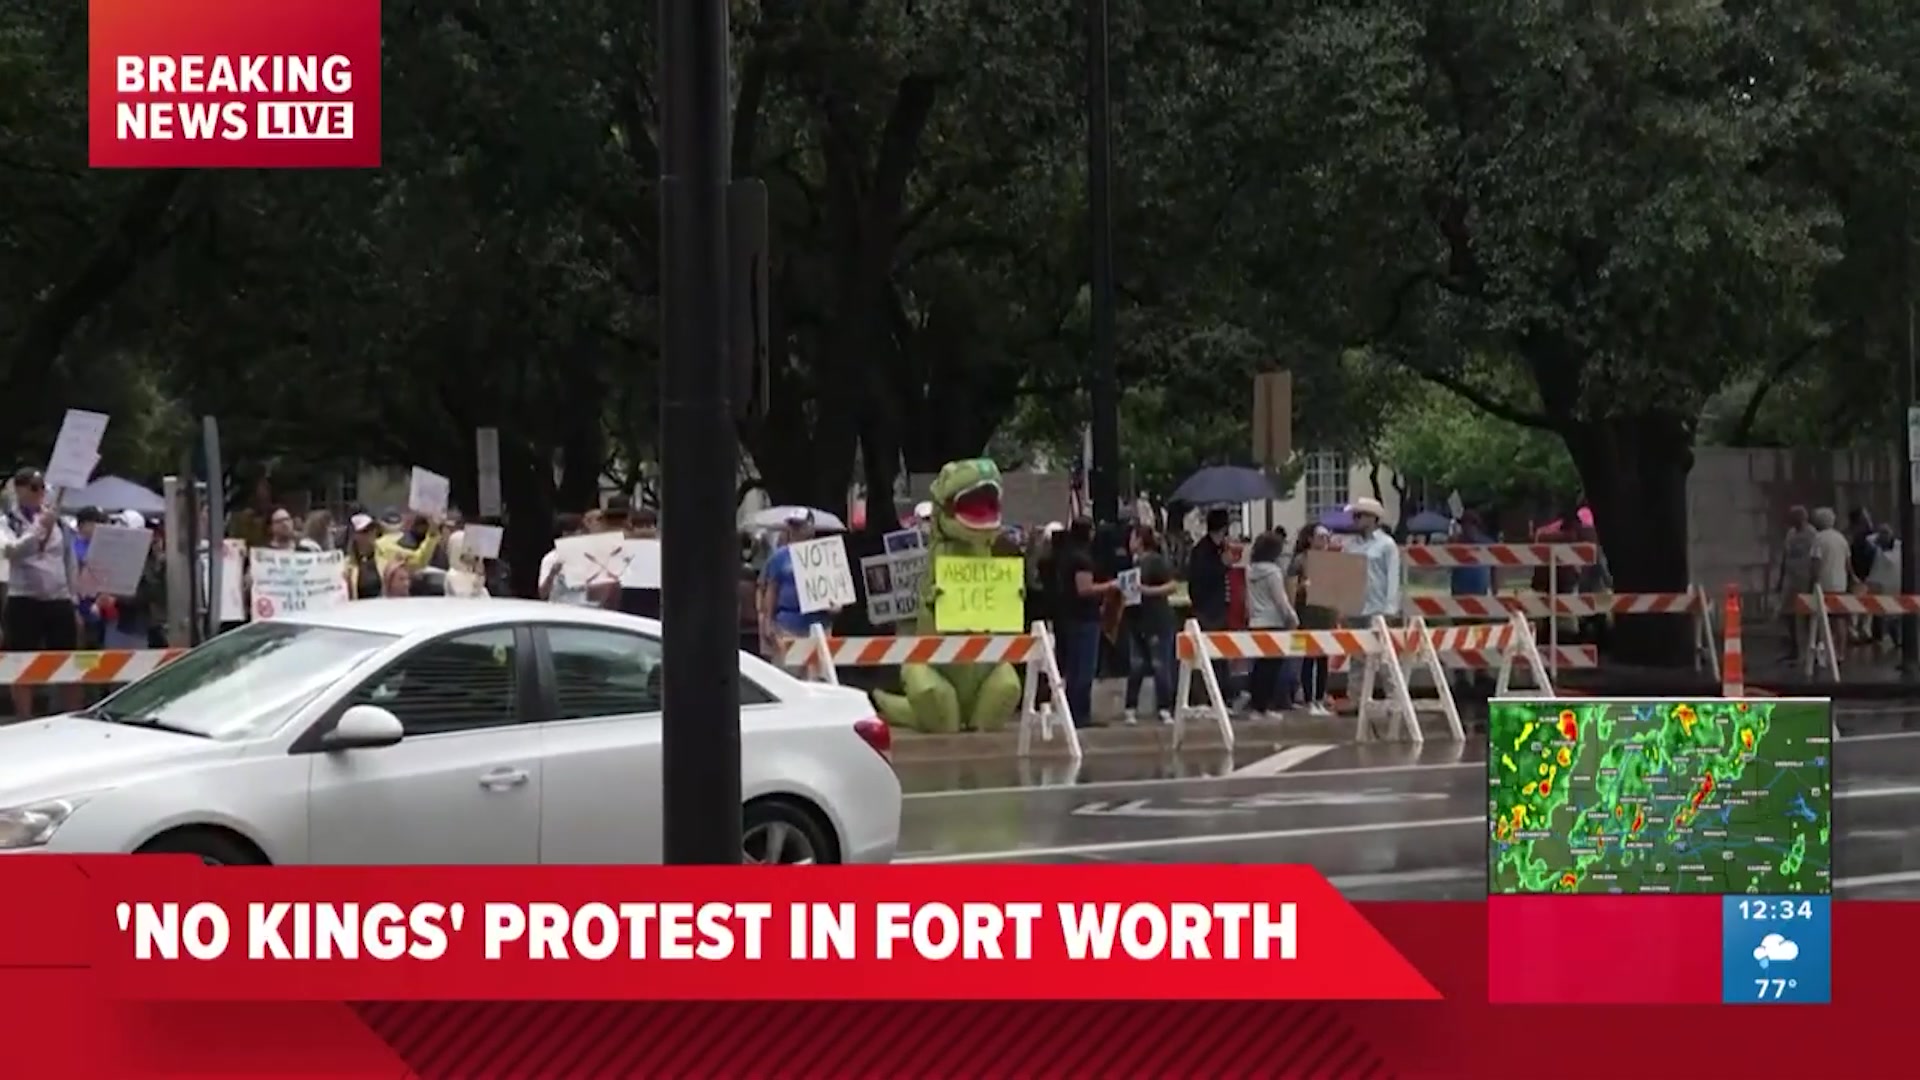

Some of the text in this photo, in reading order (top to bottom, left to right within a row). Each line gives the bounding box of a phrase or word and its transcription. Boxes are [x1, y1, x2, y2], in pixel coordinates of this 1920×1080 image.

[796, 540, 843, 568] VOTE
[944, 562, 1012, 583] ABOLISH
[958, 587, 996, 612] ICE
